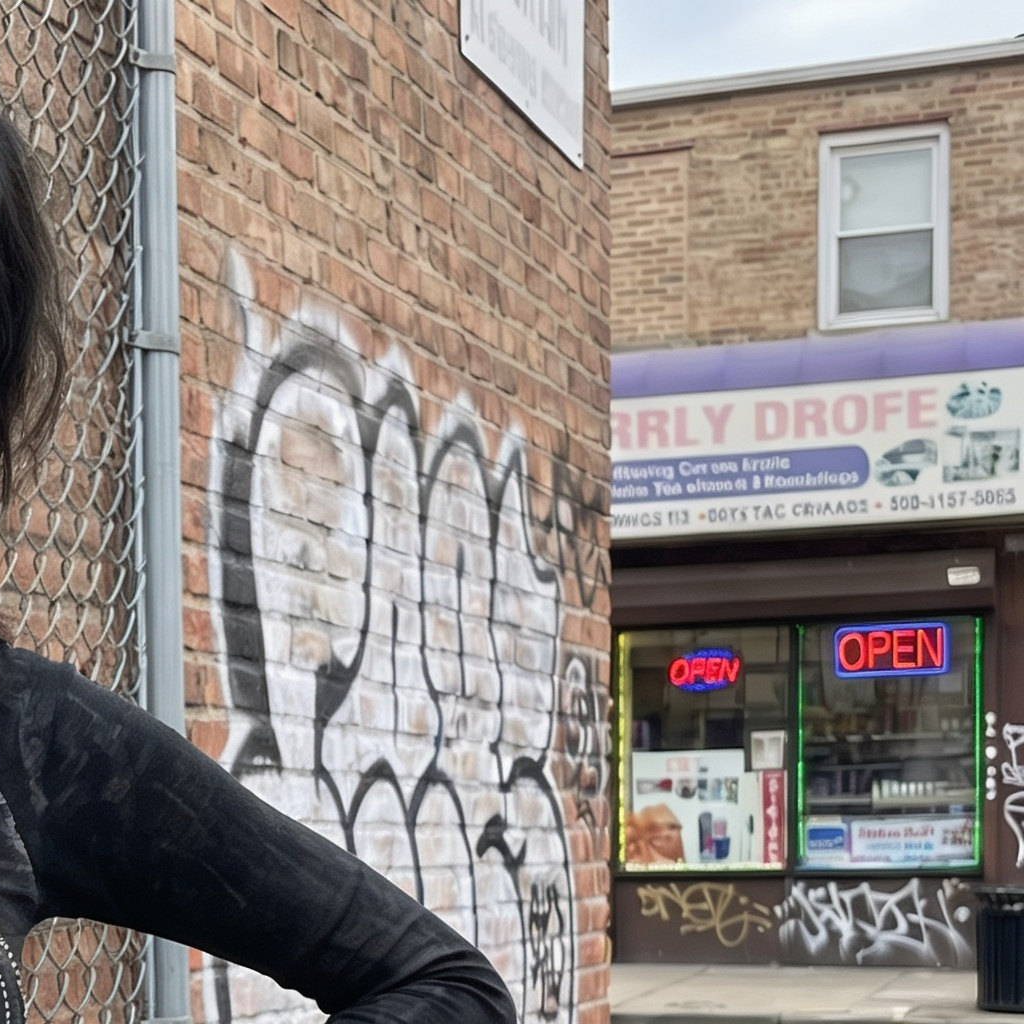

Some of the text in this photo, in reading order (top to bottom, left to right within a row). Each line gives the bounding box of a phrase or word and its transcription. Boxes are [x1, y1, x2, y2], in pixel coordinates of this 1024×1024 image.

[754, 389, 939, 442] DROFE
[839, 627, 944, 671] OPEN
[669, 656, 741, 687] OPEN
